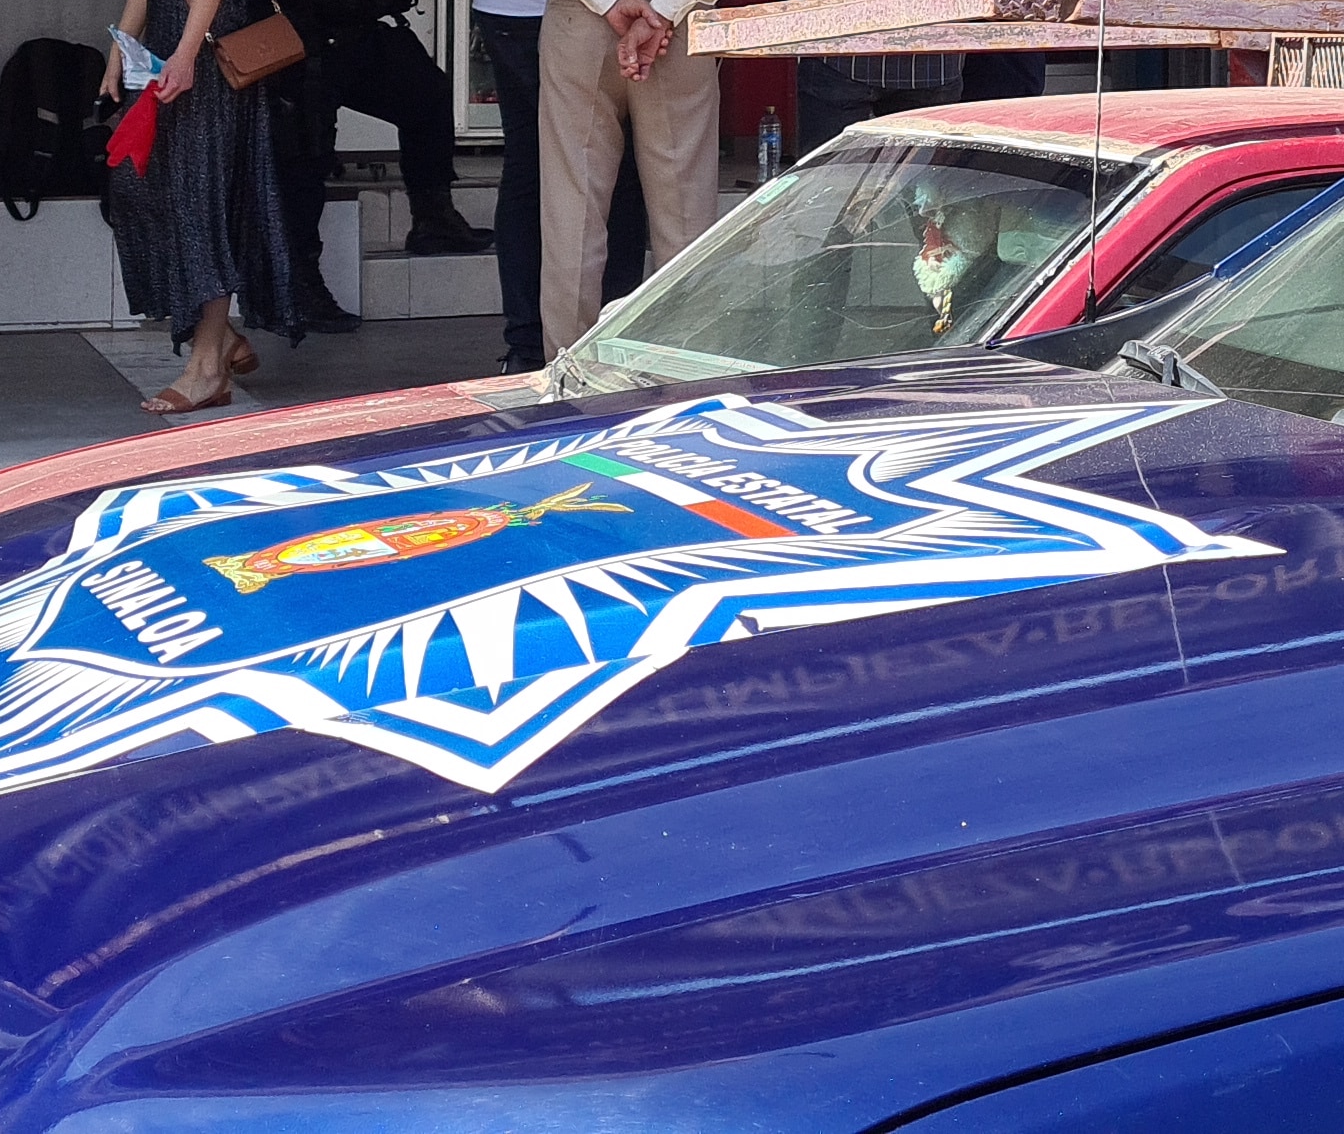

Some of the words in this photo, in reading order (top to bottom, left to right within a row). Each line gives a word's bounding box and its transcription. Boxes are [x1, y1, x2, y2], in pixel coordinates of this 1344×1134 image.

[598, 438, 740, 479] POLICÍA
[700, 471, 874, 535] ESTATAL
[80, 560, 224, 664] SINALOA
